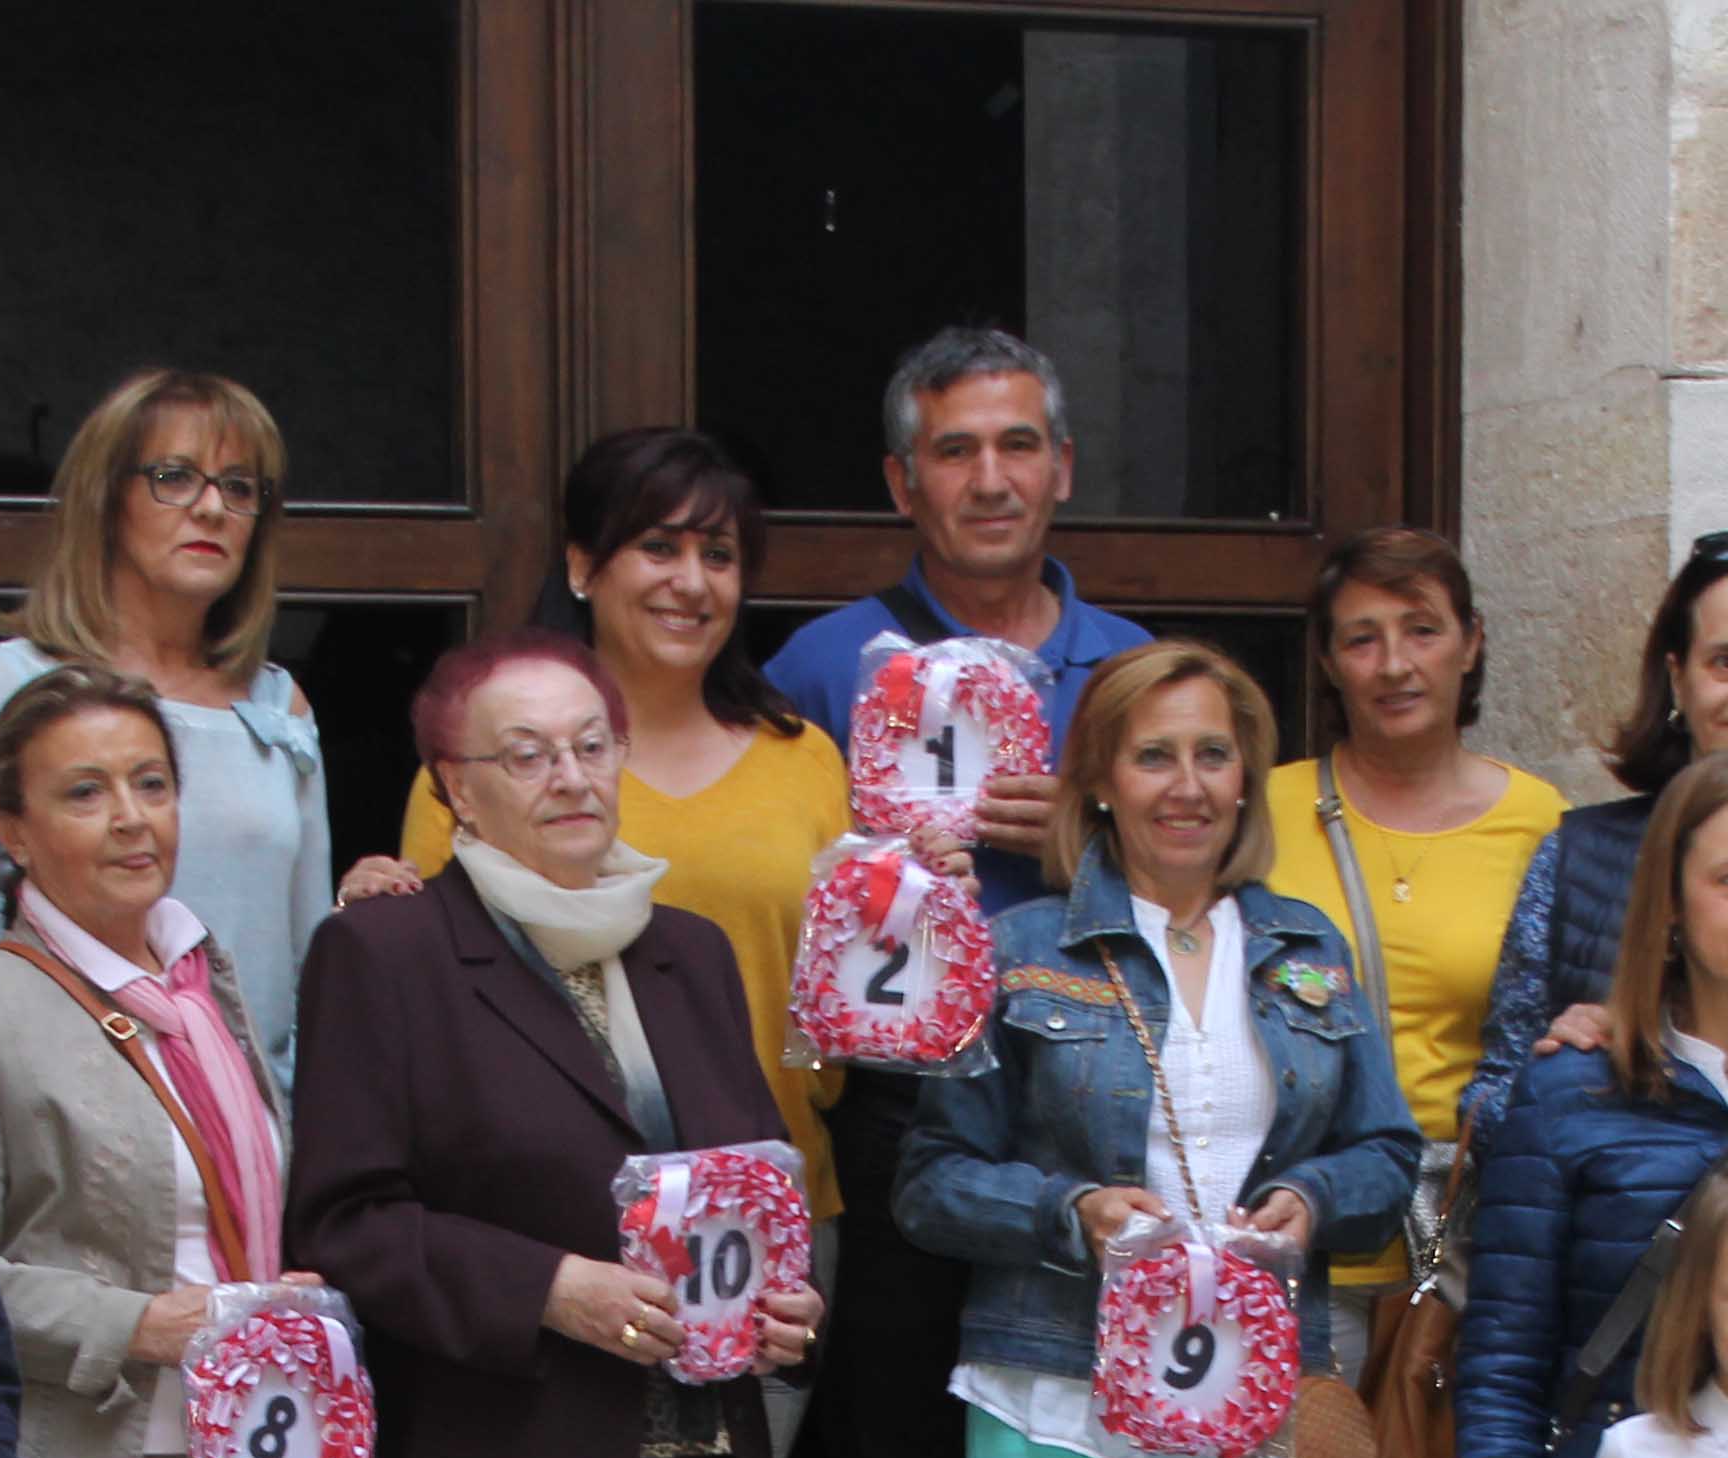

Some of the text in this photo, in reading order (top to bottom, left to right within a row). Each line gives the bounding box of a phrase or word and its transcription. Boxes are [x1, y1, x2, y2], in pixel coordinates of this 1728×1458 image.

[926, 726, 955, 795] 1
[865, 938, 910, 1006] 2
[686, 1229, 751, 1305] 10
[1162, 1324, 1216, 1390] 9
